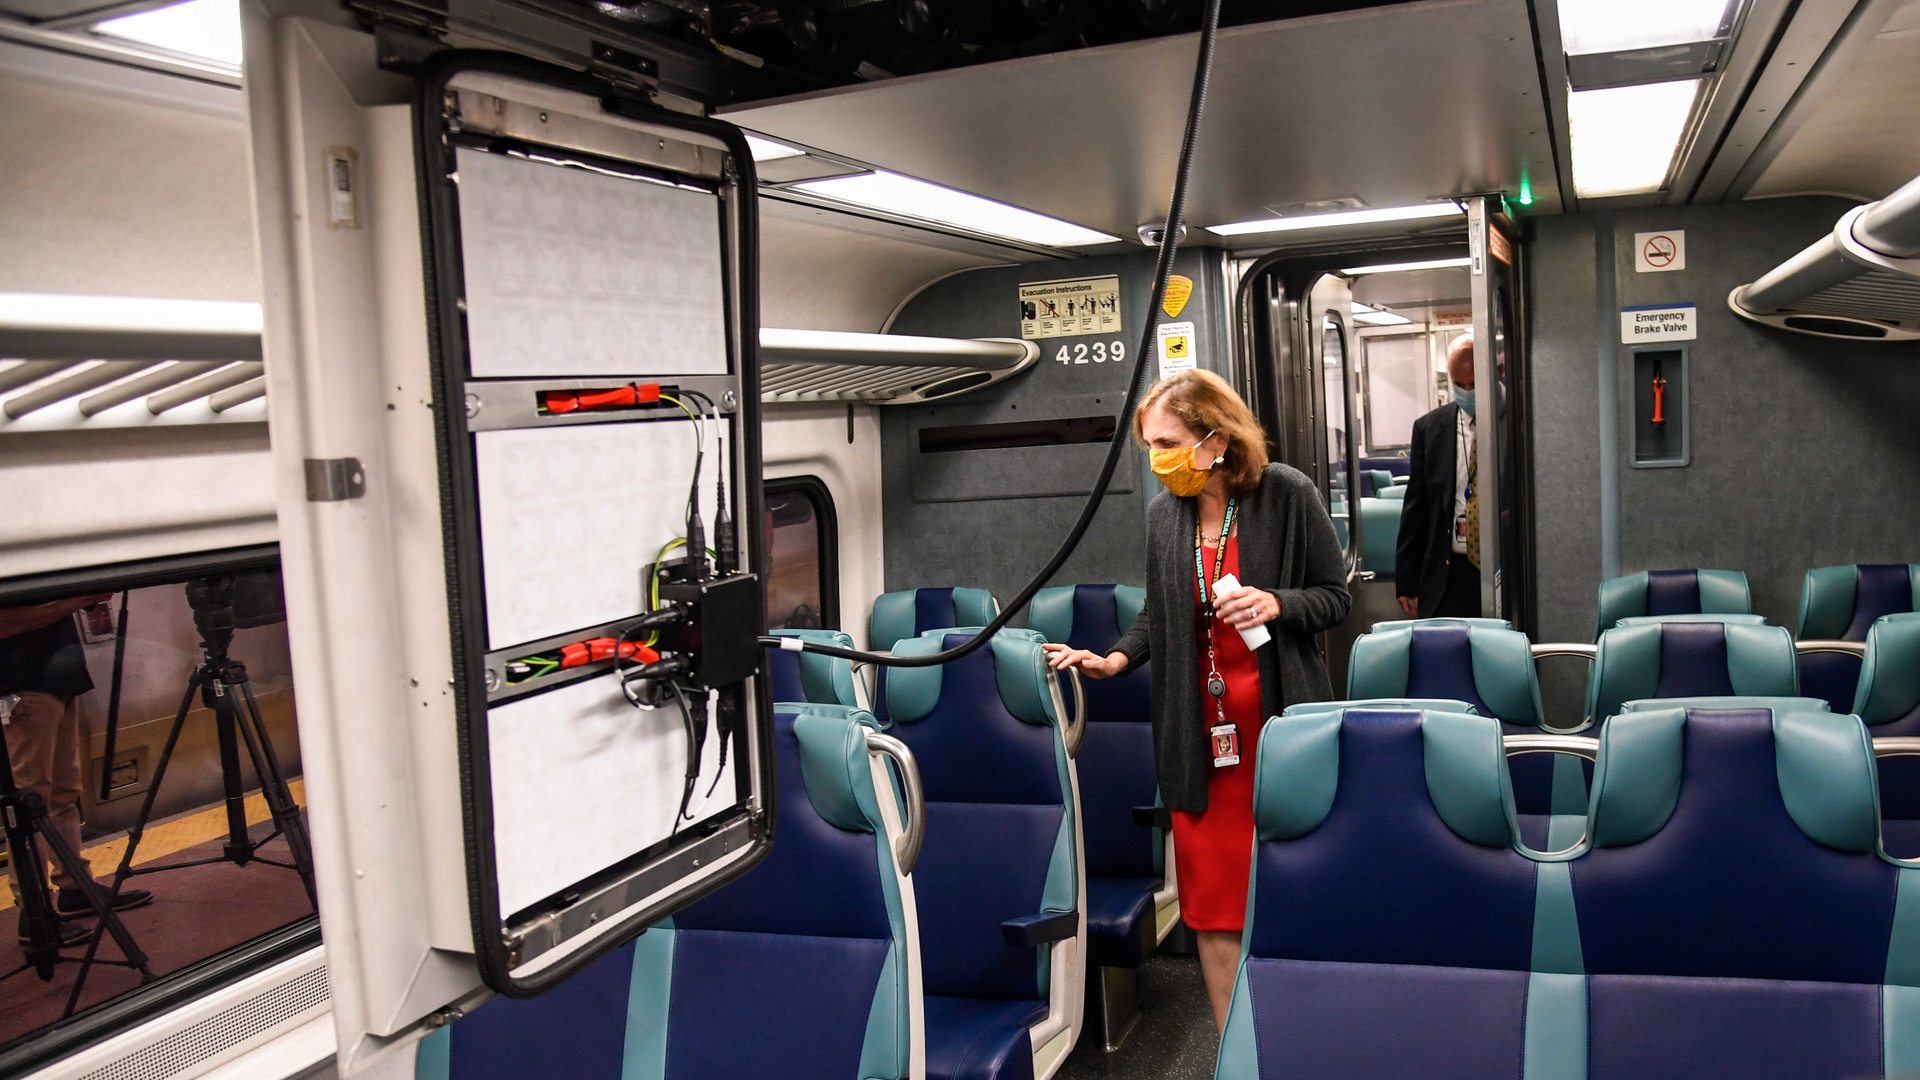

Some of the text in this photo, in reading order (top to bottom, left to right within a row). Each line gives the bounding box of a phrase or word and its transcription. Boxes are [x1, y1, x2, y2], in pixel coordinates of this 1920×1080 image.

[1022, 284, 1092, 296] Evacuation Instructions
[1634, 323, 1688, 334] Brake Valve
[1636, 312, 1685, 322] Emergency
[1056, 340, 1126, 365] 4239
[1222, 506, 1234, 536] CENTRAL
[1216, 536, 1226, 560] GRAND
[1195, 547, 1204, 578] CENTRAL
[1198, 578, 1207, 604] GRAND
[1210, 560, 1222, 602] CENTAL
